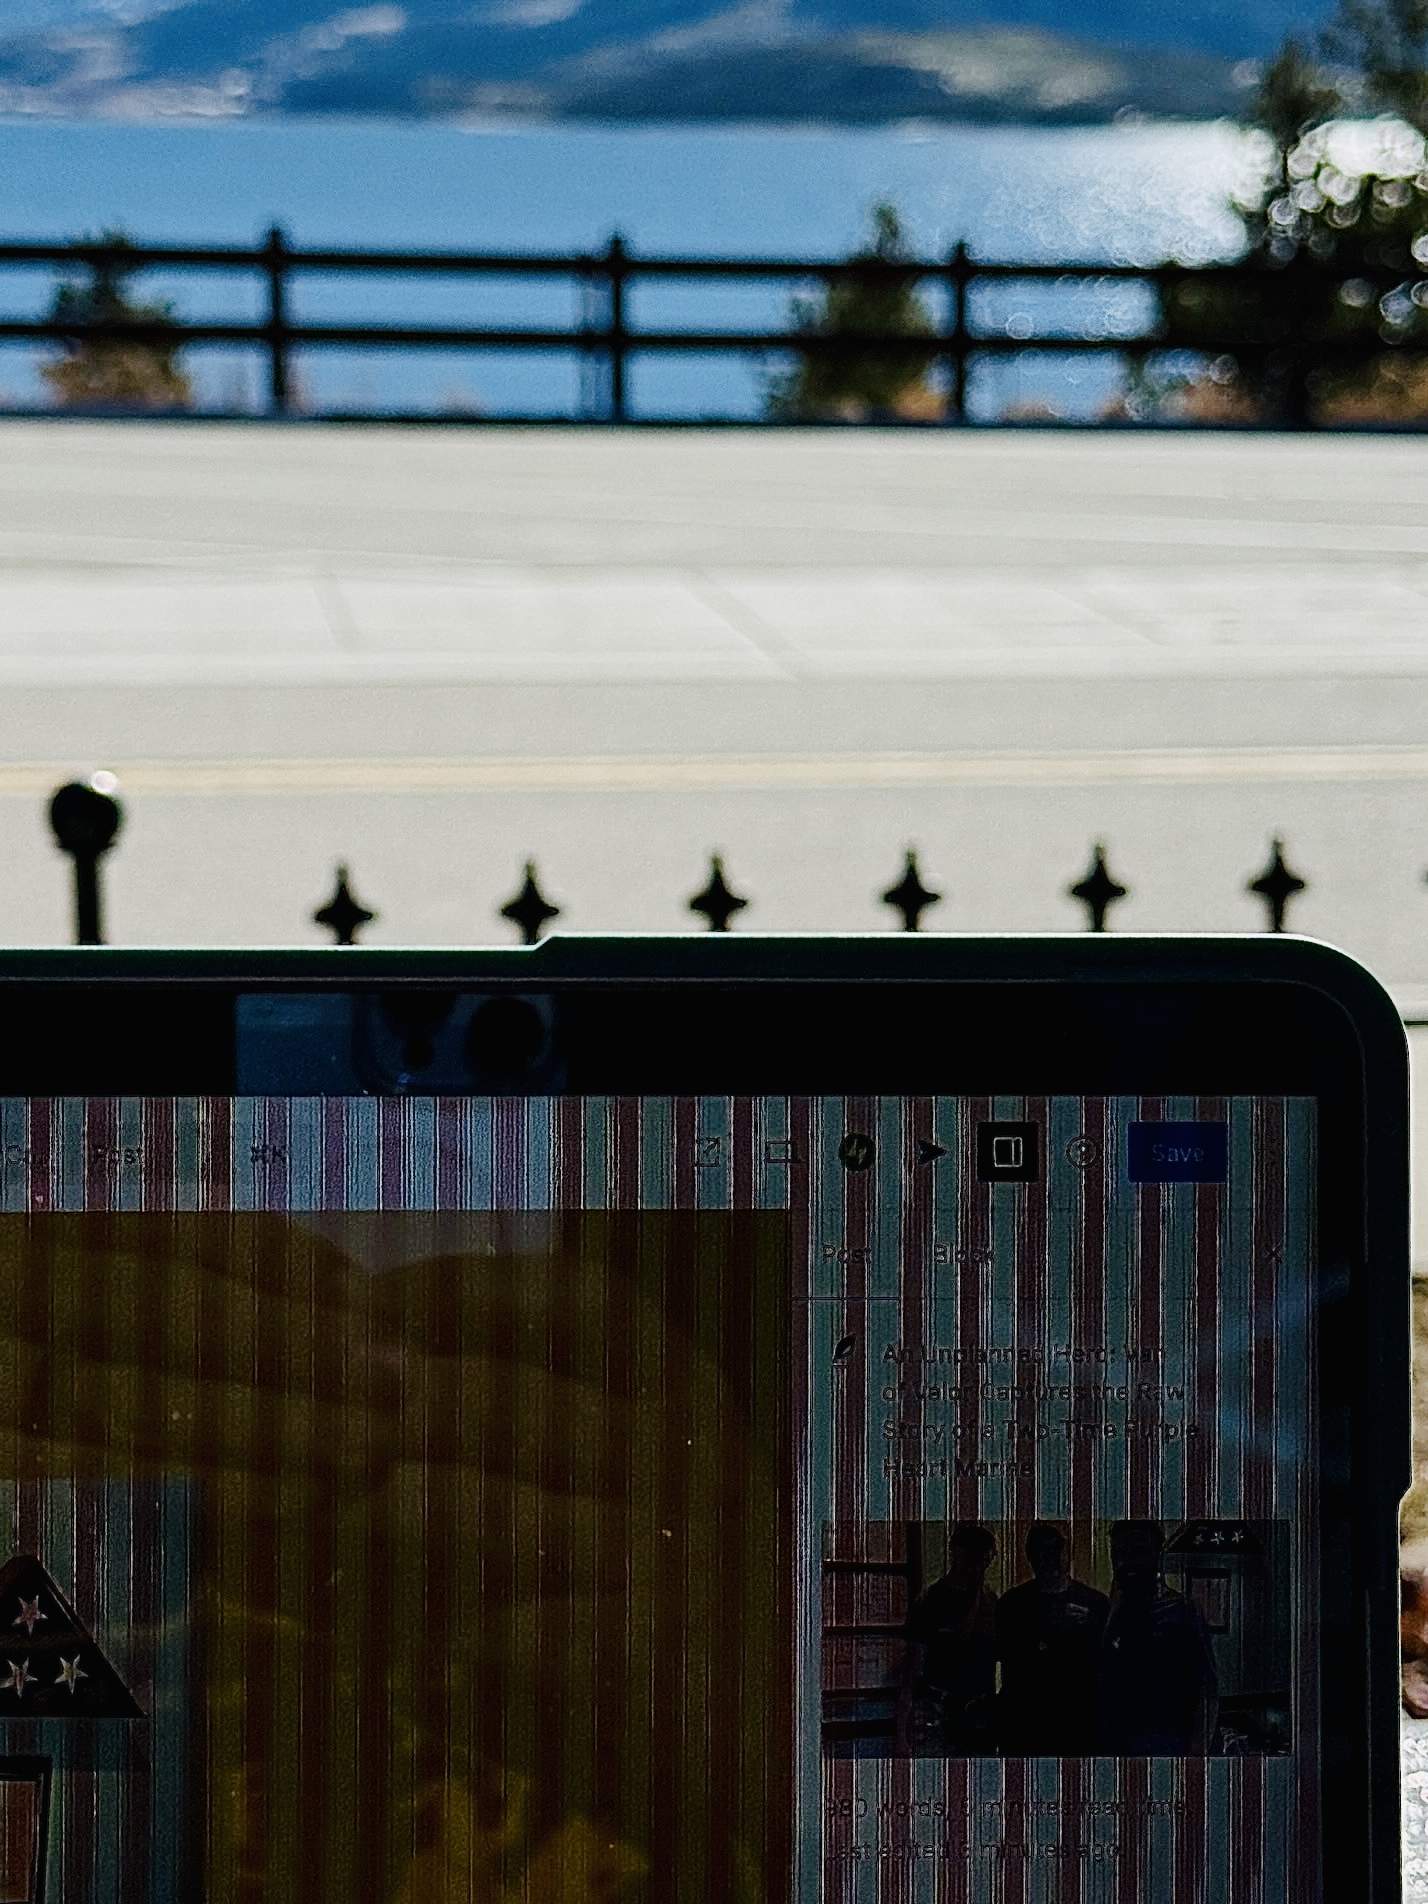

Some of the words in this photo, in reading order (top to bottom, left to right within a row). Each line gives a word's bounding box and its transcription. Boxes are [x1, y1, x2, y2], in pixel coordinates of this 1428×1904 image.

[1151, 1143, 1205, 1163] Save
[822, 1245, 872, 1263] Post
[933, 1245, 996, 1263] Block
